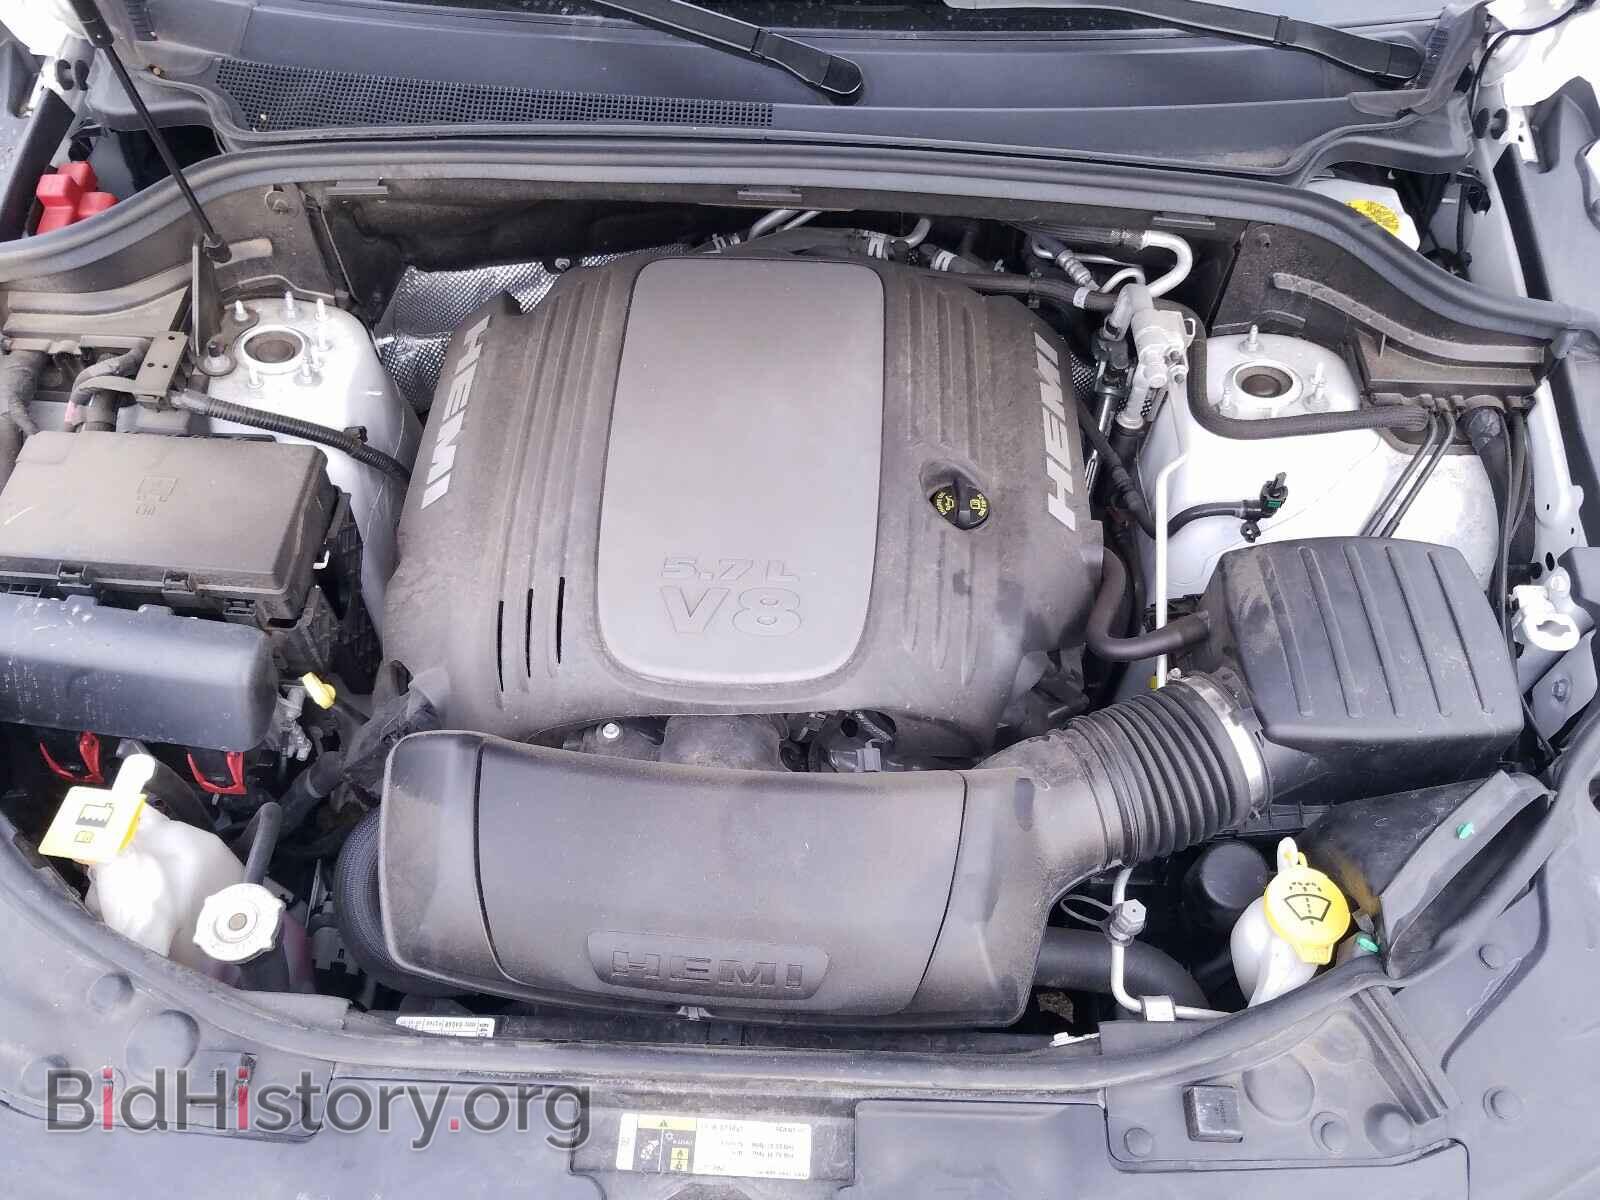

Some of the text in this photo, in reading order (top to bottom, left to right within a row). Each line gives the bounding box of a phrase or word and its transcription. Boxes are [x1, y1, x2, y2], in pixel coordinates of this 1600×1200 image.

[421, 314, 491, 510] HEMI
[1034, 332, 1076, 531] HEMI
[659, 586, 802, 637] V8
[612, 950, 803, 989] HEMI
